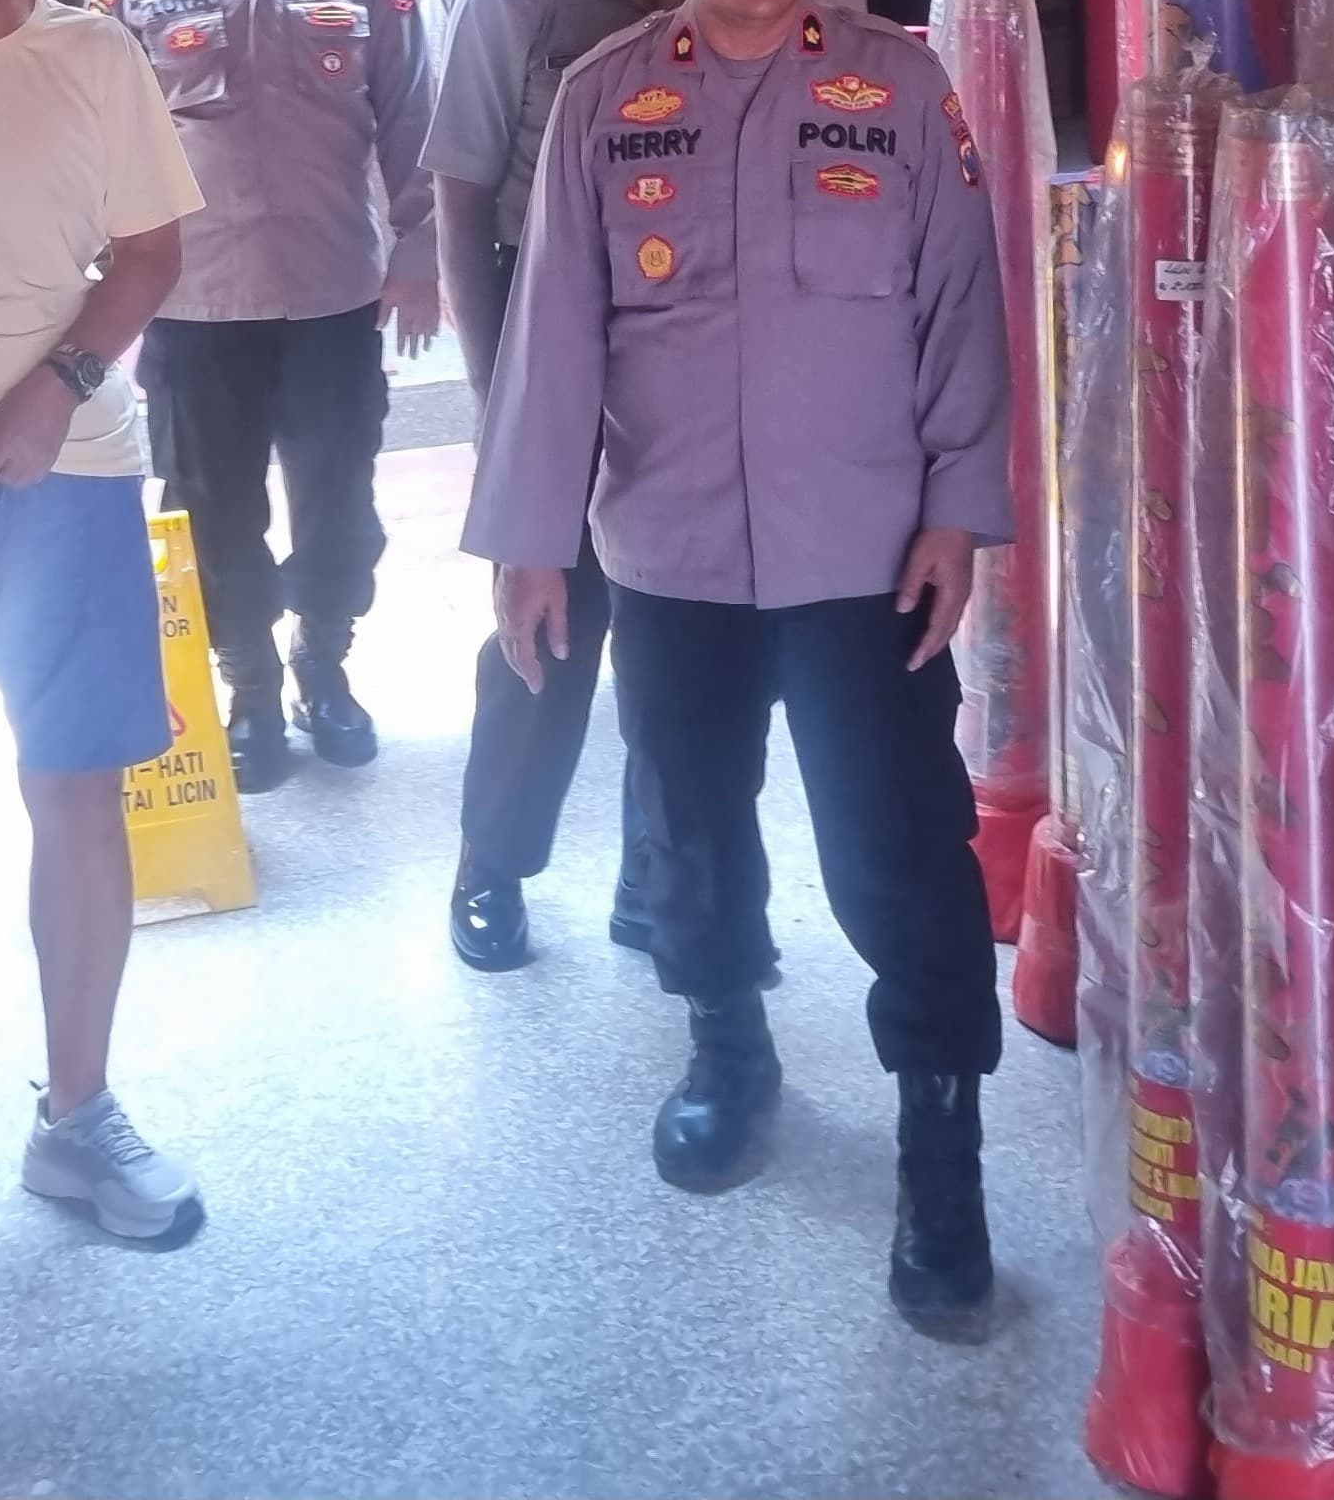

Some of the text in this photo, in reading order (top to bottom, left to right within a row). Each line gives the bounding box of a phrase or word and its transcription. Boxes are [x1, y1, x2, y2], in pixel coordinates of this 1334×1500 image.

[607, 128, 702, 164] HERRY
[798, 122, 896, 156] POLRI
[166, 777, 217, 807] LICIN
